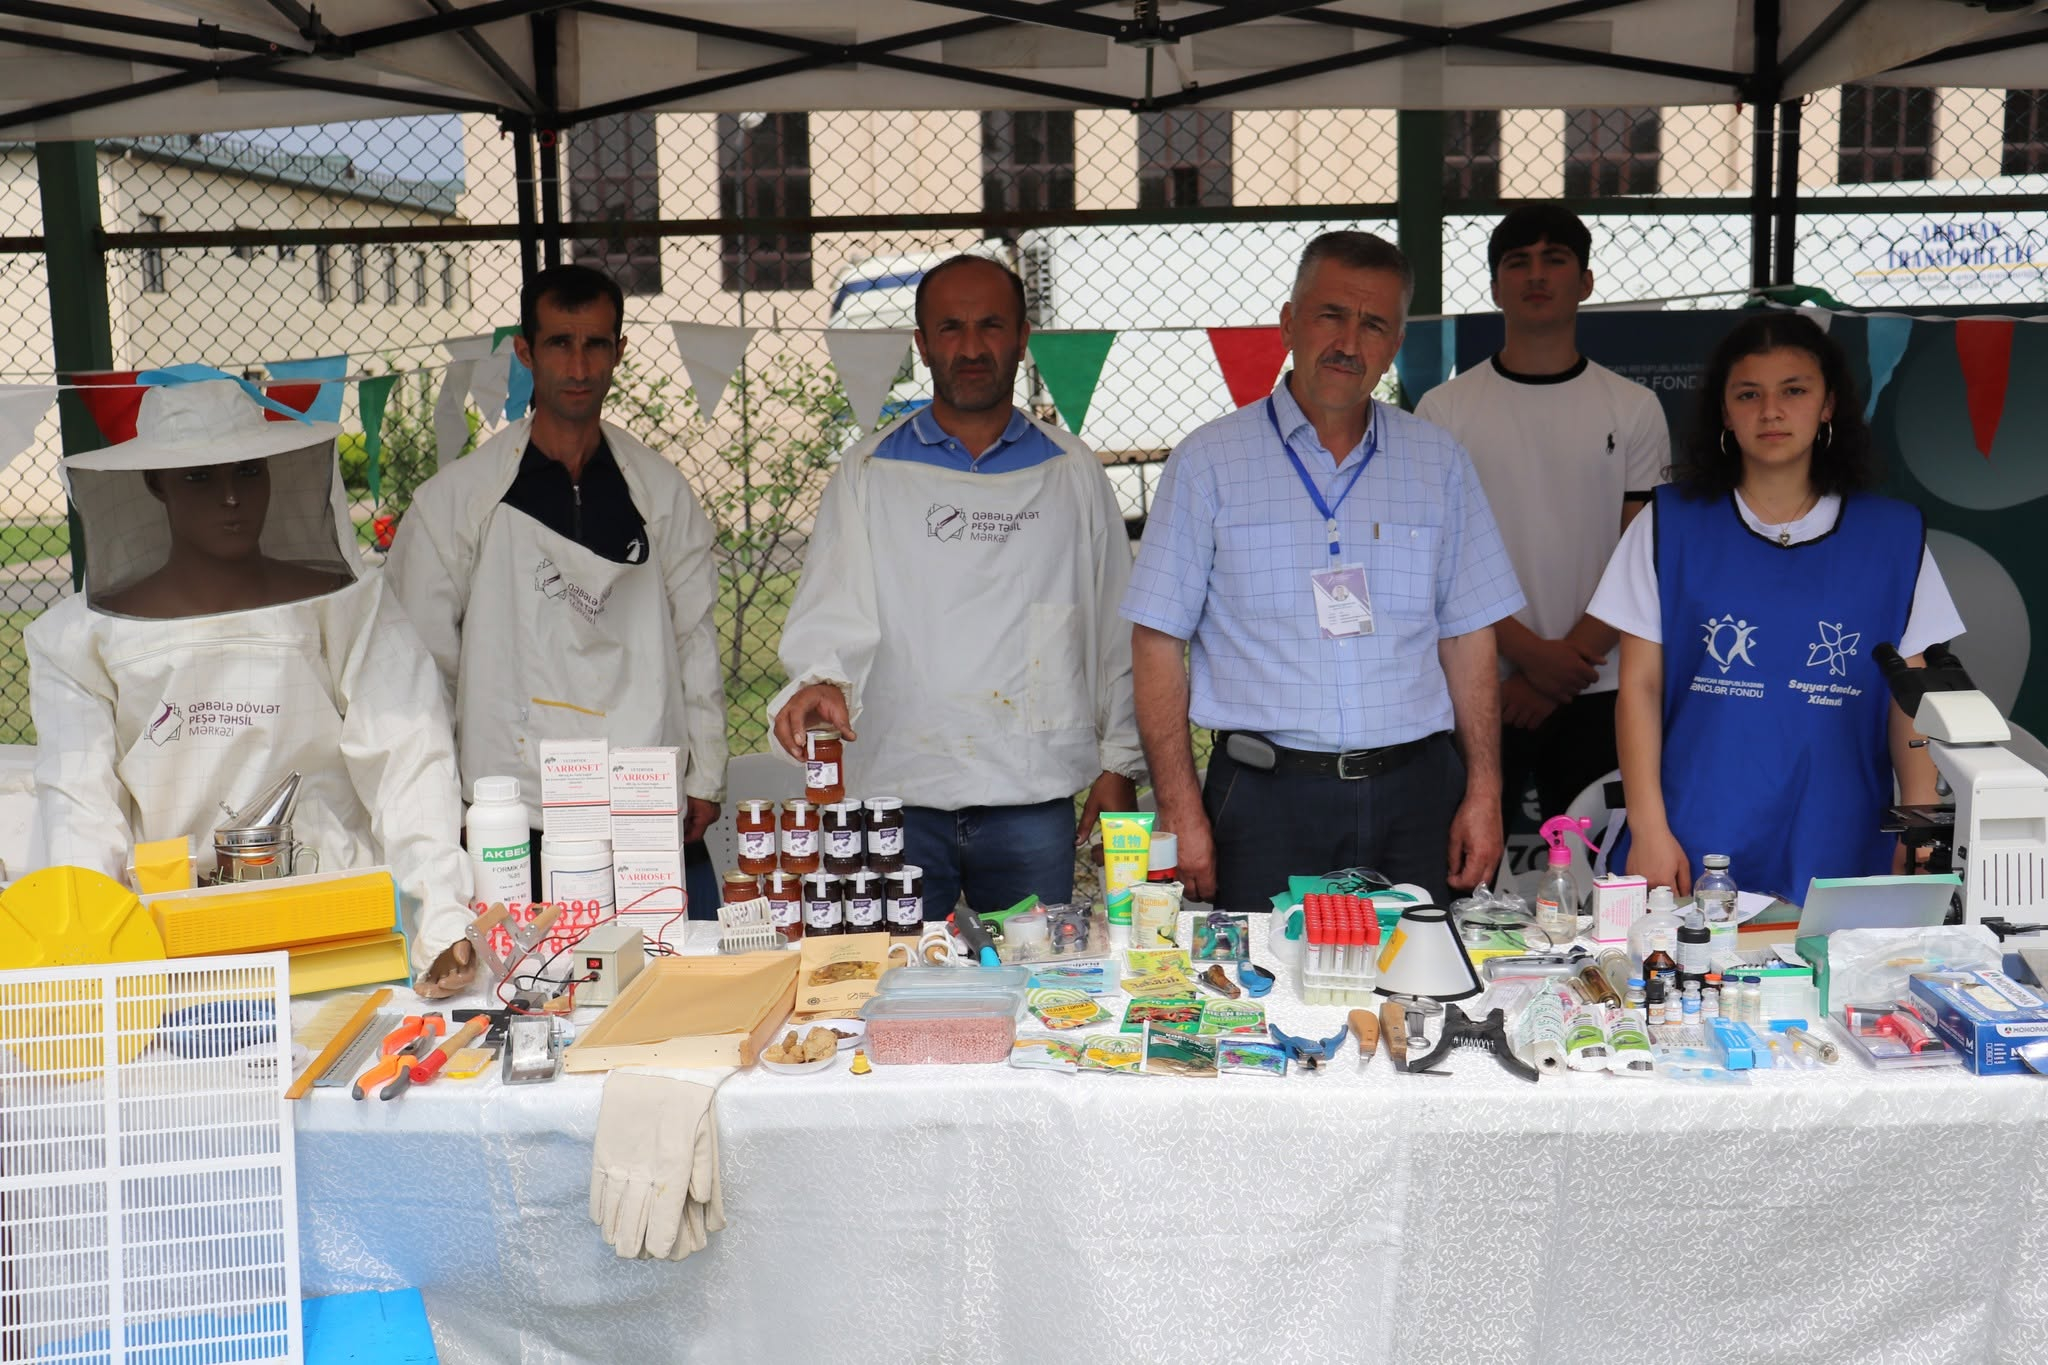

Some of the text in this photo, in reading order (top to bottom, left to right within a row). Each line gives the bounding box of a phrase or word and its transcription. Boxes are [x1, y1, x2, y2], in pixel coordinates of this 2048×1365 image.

[1889, 245, 1997, 269] TRANSPORT
[971, 522, 996, 532] PEŞƏ
[1729, 687, 1764, 699] FONDU
[188, 701, 281, 714] QƏBƏLƏ DÖVLƏT
[188, 714, 253, 726] PEŞƏ TƏHSİL
[188, 726, 234, 737] MƏRKƏZİ
[1112, 834, 1142, 848] 植物
[484, 847, 529, 859] AKBEL
[1965, 1037, 1974, 1050] M
